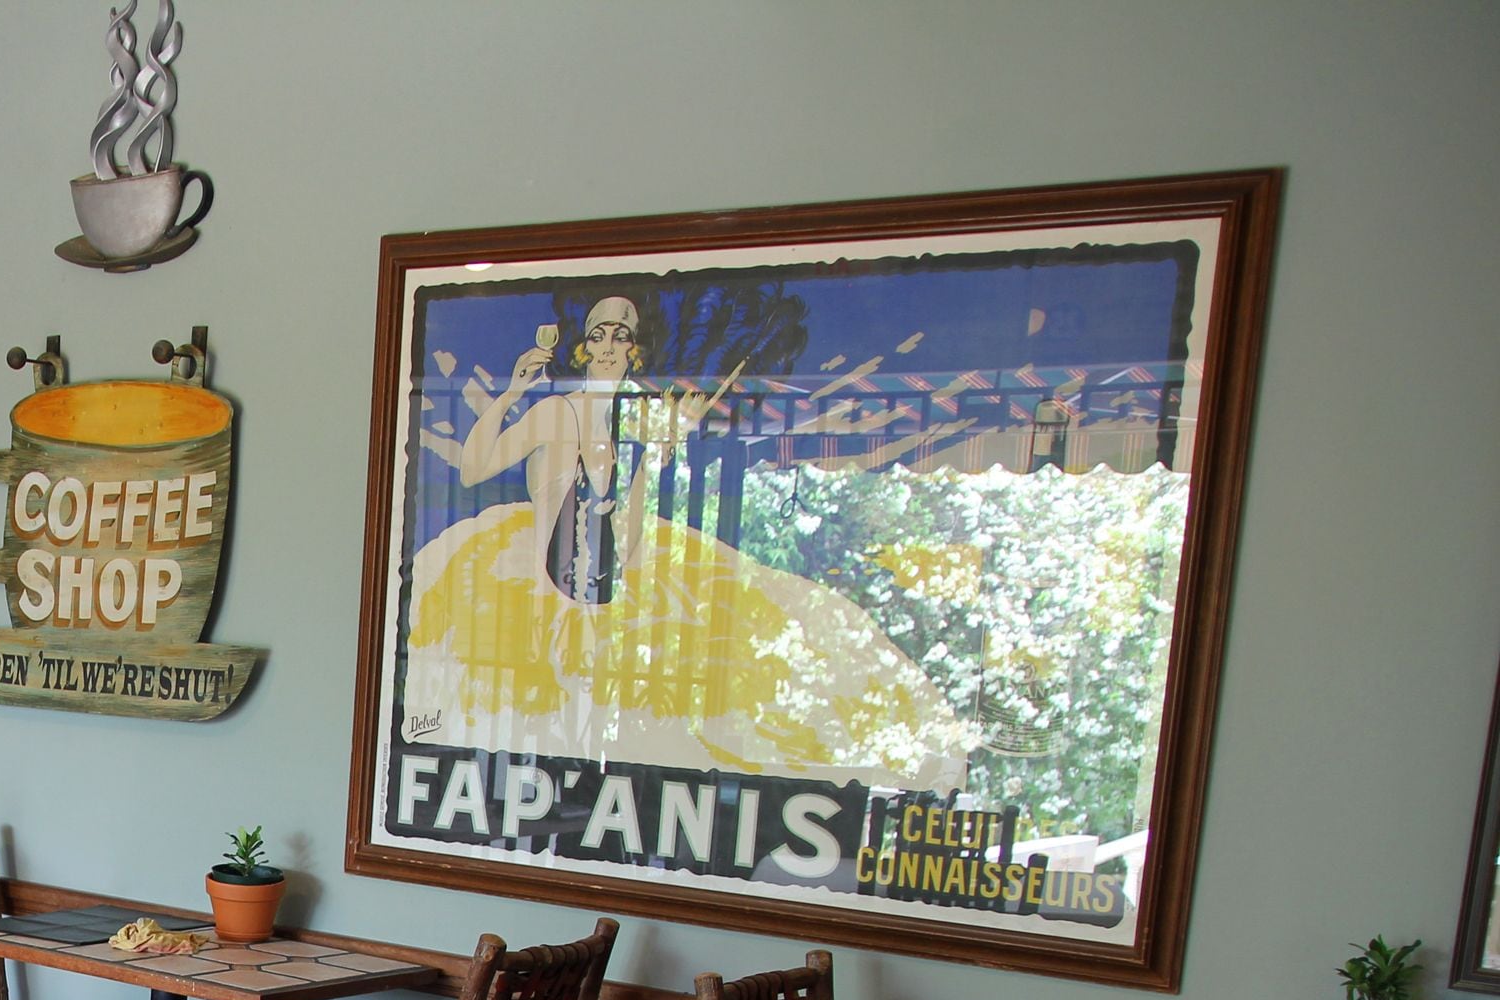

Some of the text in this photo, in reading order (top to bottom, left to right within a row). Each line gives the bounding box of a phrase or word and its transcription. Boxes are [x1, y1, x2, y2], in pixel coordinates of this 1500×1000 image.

[12, 470, 217, 547] COFFEE
[16, 548, 183, 631] SHOP
[37, 650, 78, 690] 'TIL
[82, 655, 154, 698] WE'RE
[158, 664, 235, 705] SHUT!
[397, 753, 842, 879] FAP'ANIS
[856, 846, 1116, 914] CONNAISSEURS
